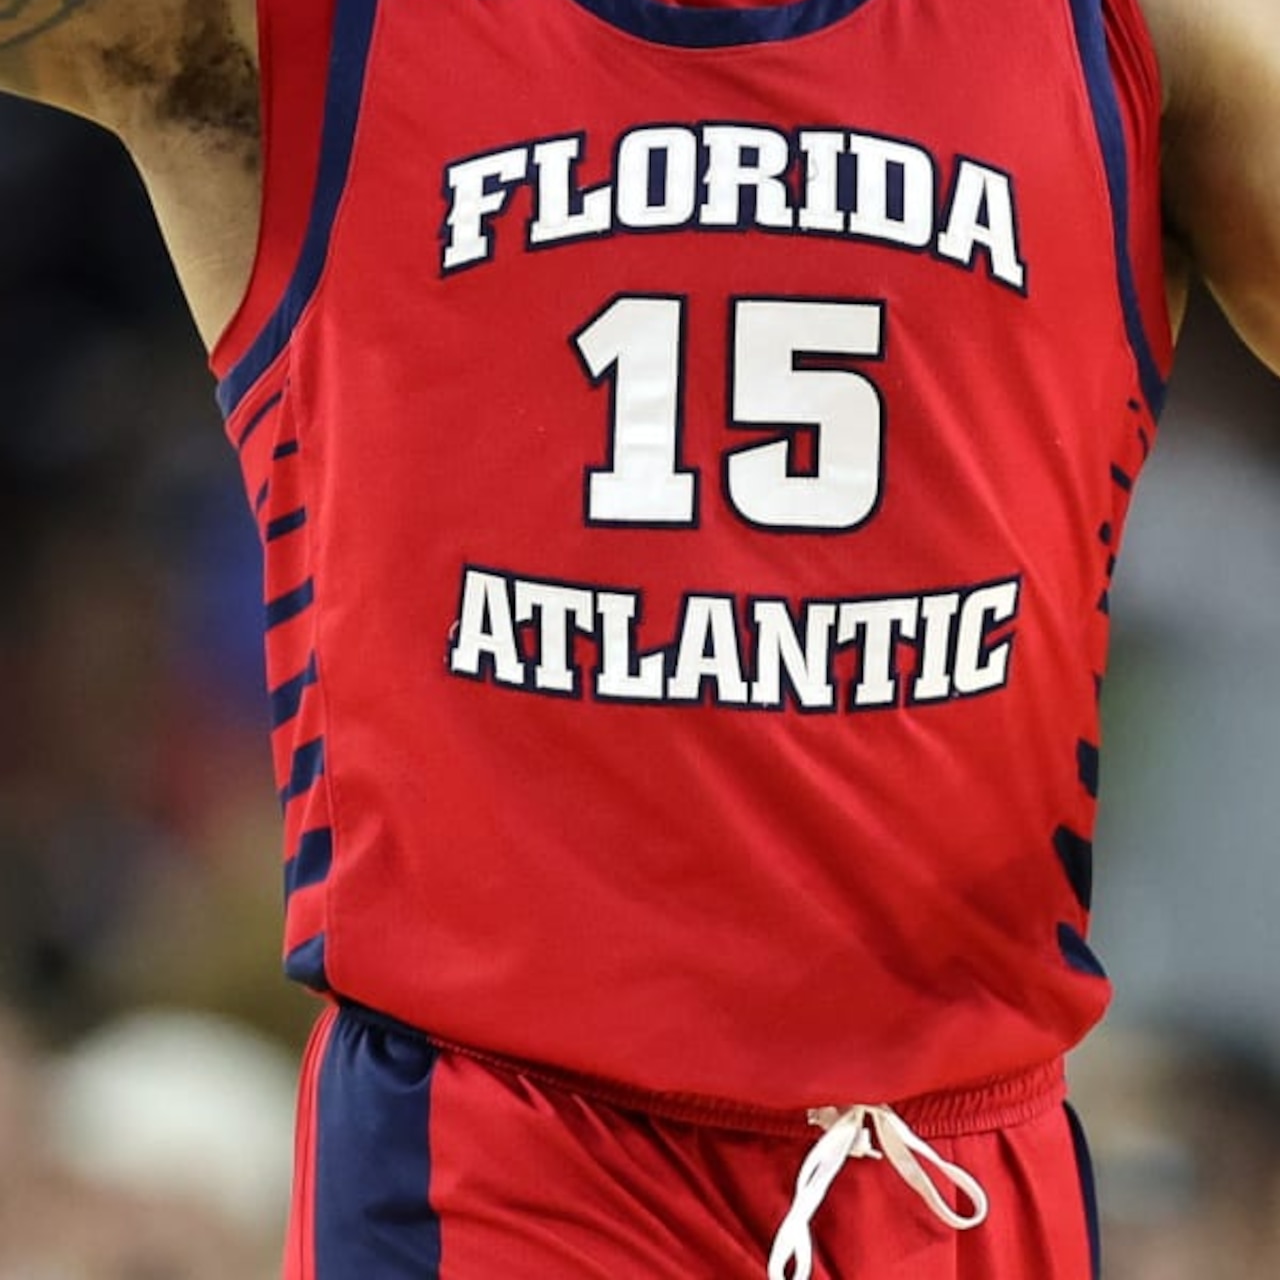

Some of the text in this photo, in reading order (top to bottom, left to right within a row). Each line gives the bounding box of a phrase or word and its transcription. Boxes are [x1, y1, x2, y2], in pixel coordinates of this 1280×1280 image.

[439, 121, 1027, 295] FLORIDA
[572, 293, 886, 533] 15
[448, 565, 1021, 714] ATLANTIC
